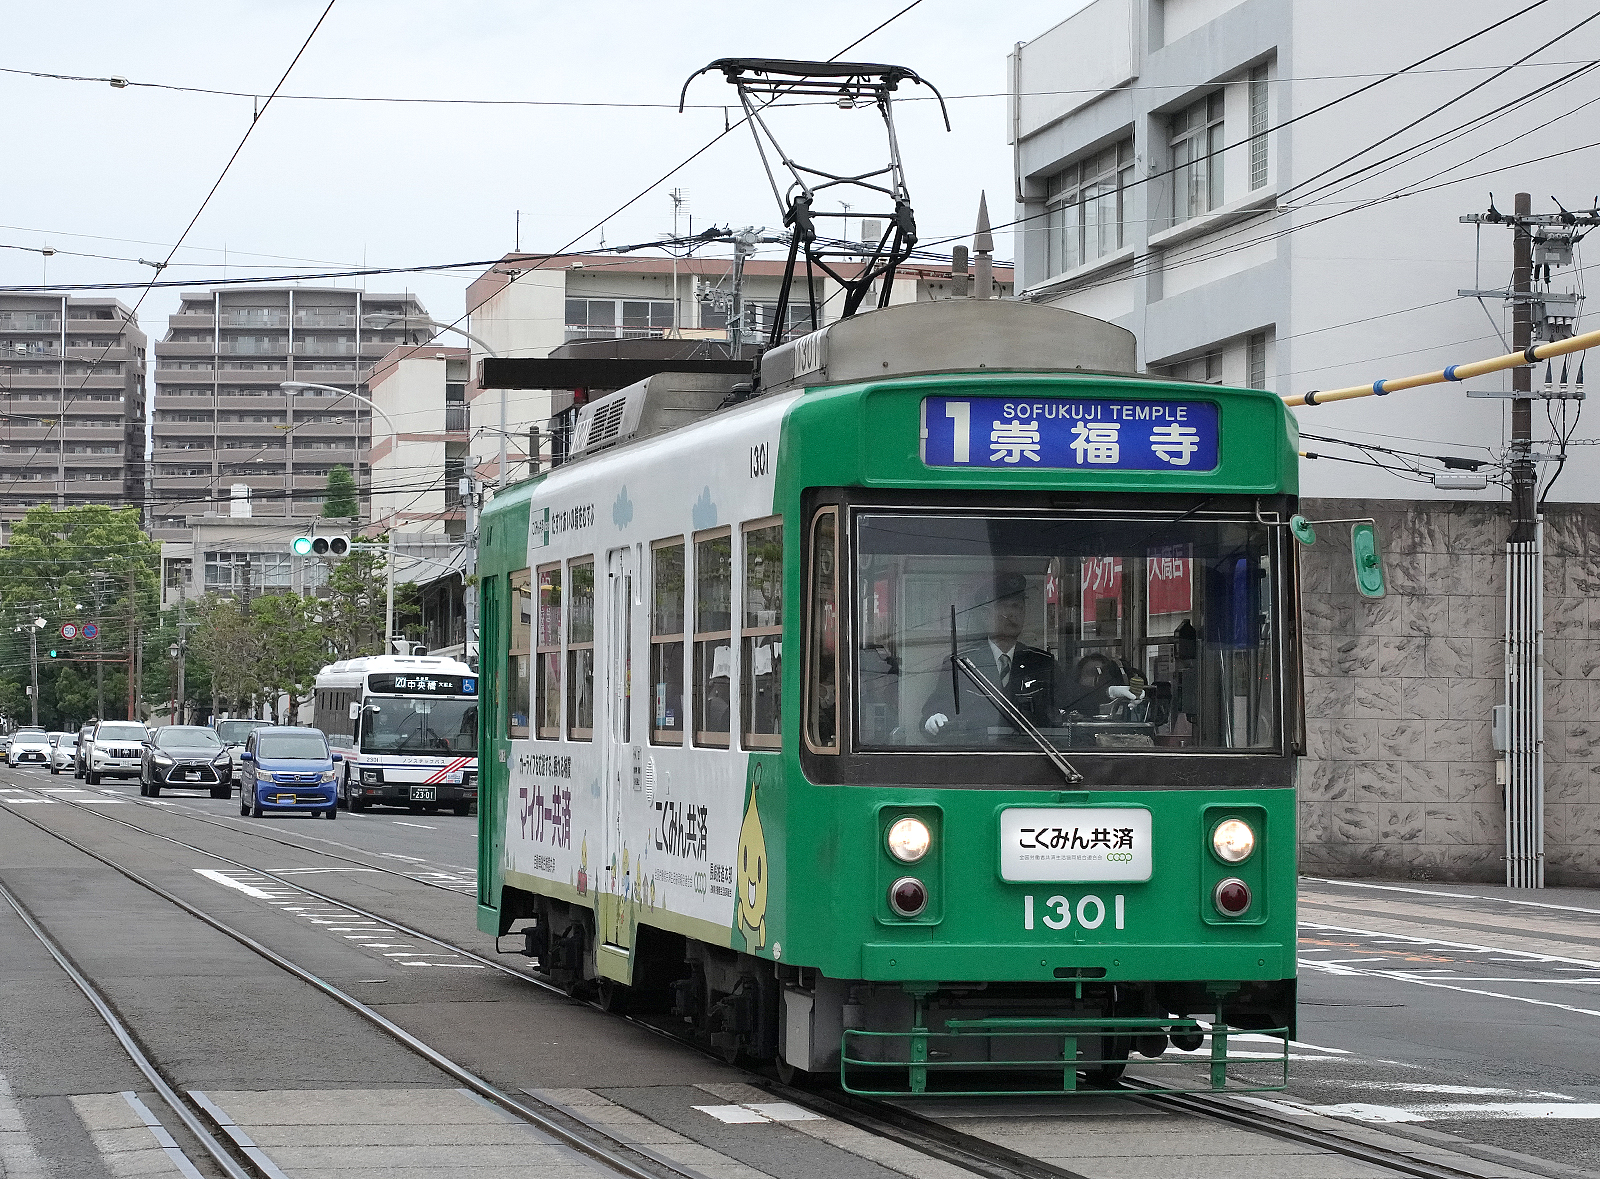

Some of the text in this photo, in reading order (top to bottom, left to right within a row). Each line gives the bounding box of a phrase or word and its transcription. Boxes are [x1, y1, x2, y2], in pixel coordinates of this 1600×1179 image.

[1003, 403, 1188, 421] SOFUKUJI TEMPLE
[945, 402, 971, 463] 1
[989, 420, 1200, 466] 崇福寺
[750, 441, 769, 478] 1301
[64, 627, 75, 635] 50
[407, 680, 436, 691] 中央橋
[519, 784, 572, 850] マイカー共済
[655, 800, 708, 862] こくみん共済
[1019, 827, 1134, 850] こくみん共済
[1106, 852, 1133, 864] coop
[1024, 894, 1125, 930] 1301
